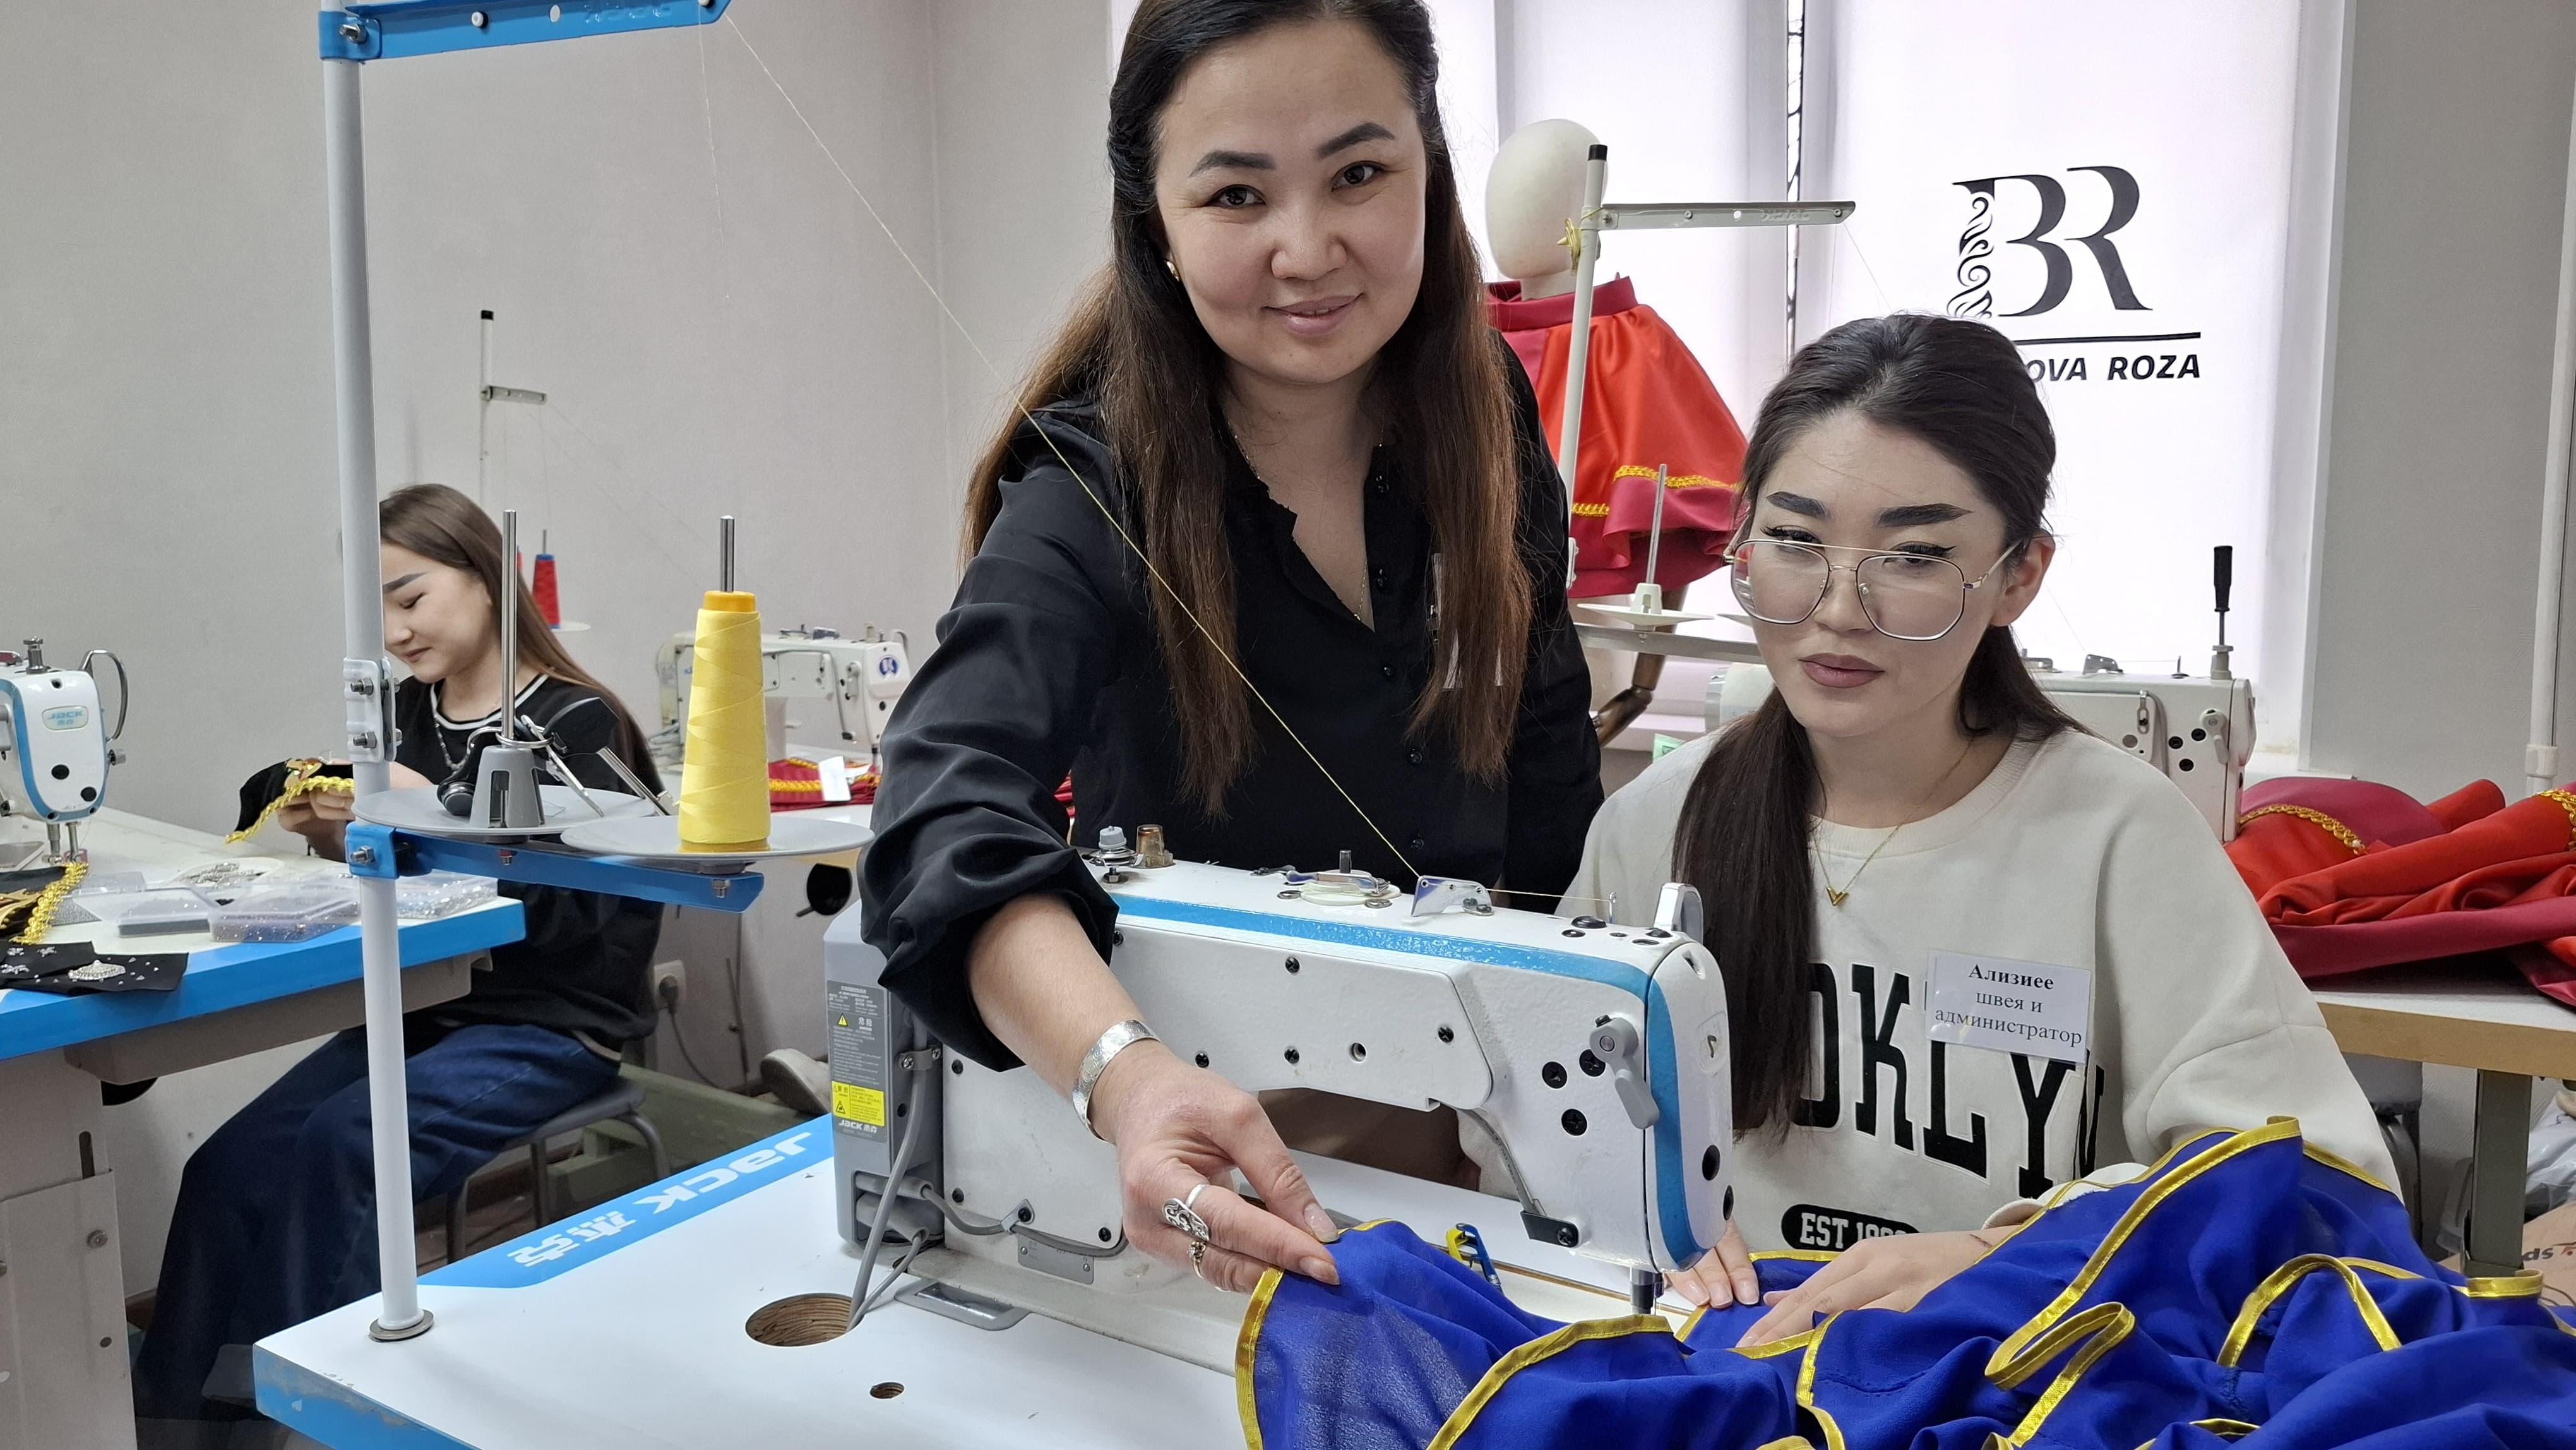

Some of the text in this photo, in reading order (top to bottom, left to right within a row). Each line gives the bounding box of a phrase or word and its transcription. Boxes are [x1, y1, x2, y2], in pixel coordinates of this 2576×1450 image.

[2108, 354, 2200, 381] ROZA
[1975, 992, 2042, 1013] швея и
[1935, 1010, 2082, 1046] администратор
[1799, 1212, 1849, 1249] EST
